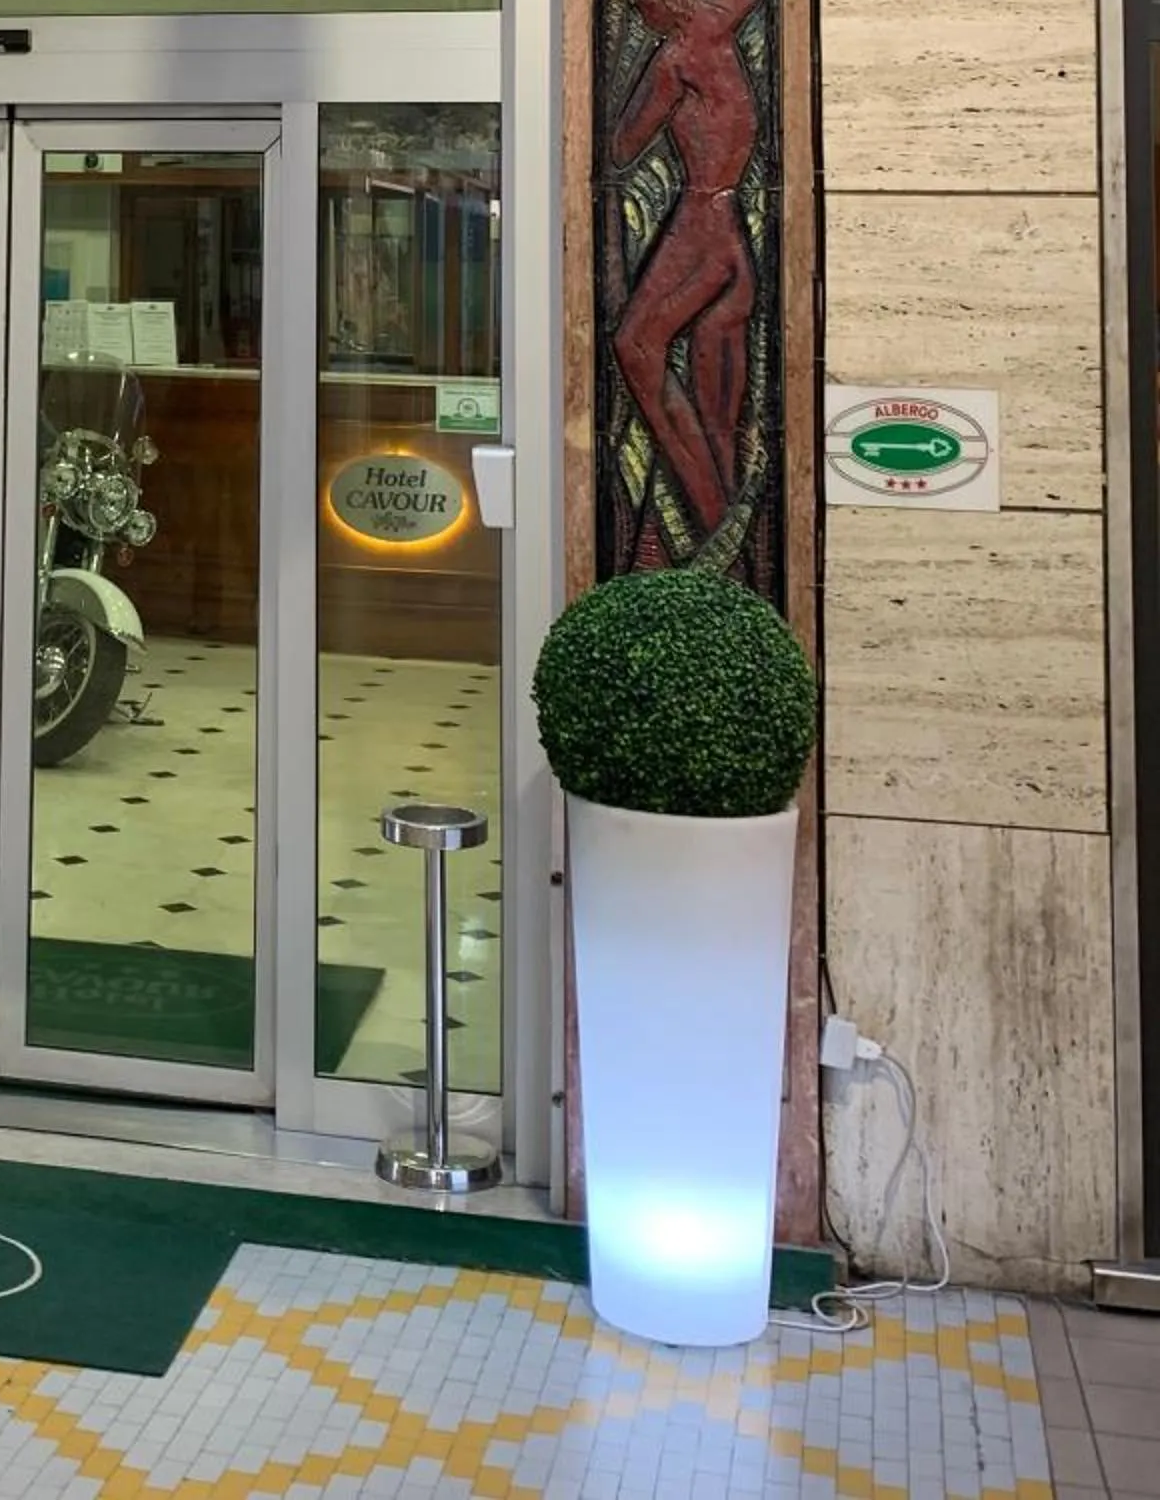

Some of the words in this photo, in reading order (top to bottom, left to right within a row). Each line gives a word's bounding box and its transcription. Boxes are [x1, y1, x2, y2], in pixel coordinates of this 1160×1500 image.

[875, 403, 939, 420] ALBERGO
[364, 467, 427, 488] Hotel
[346, 489, 447, 513] CAVOUR
